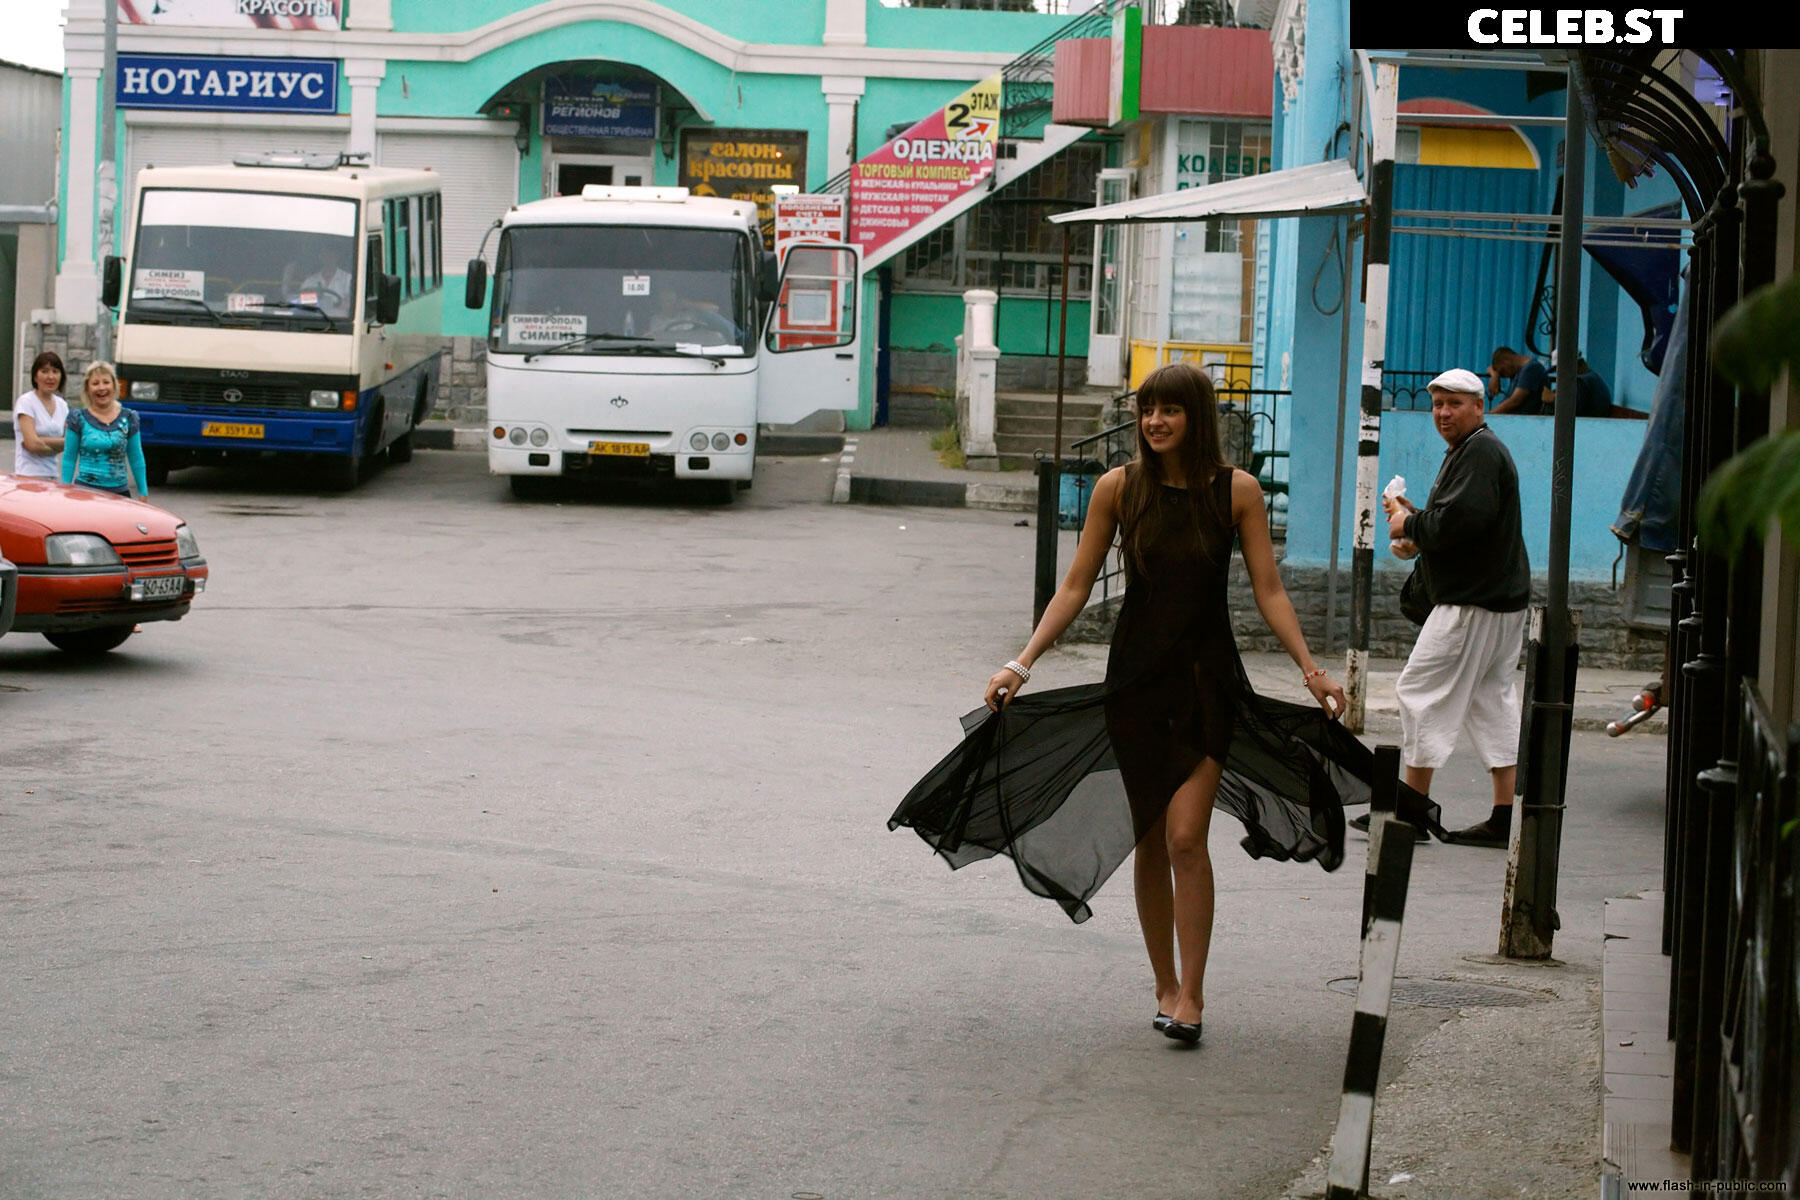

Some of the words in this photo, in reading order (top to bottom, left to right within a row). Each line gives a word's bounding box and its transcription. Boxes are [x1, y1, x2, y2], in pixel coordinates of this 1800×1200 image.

[236, 0, 335, 16] КРАСОТЫ
[123, 67, 325, 99] НОТАРИУС
[551, 106, 621, 119] РЕГИОНОВ
[948, 104, 970, 127] 2
[970, 93, 1000, 110] ЭТАЖ
[546, 124, 609, 136] ОБЩЕСТВЕННАЯ
[710, 142, 777, 159] салон
[893, 139, 994, 164] ОДЕЖДА
[690, 159, 793, 182] красоты
[858, 163, 914, 179] ТОРГОВЫЙ
[916, 166, 971, 180] КОМПЛЕКС
[861, 179, 904, 188] ЖЕНСКАЯ
[861, 192, 904, 201] МУЖСКАЯ
[911, 194, 949, 203] ТРИКОТАЖ
[860, 205, 901, 214] ДЕТСКАЯ
[513, 316, 582, 325] СИМФЕРОПОЛЬ
